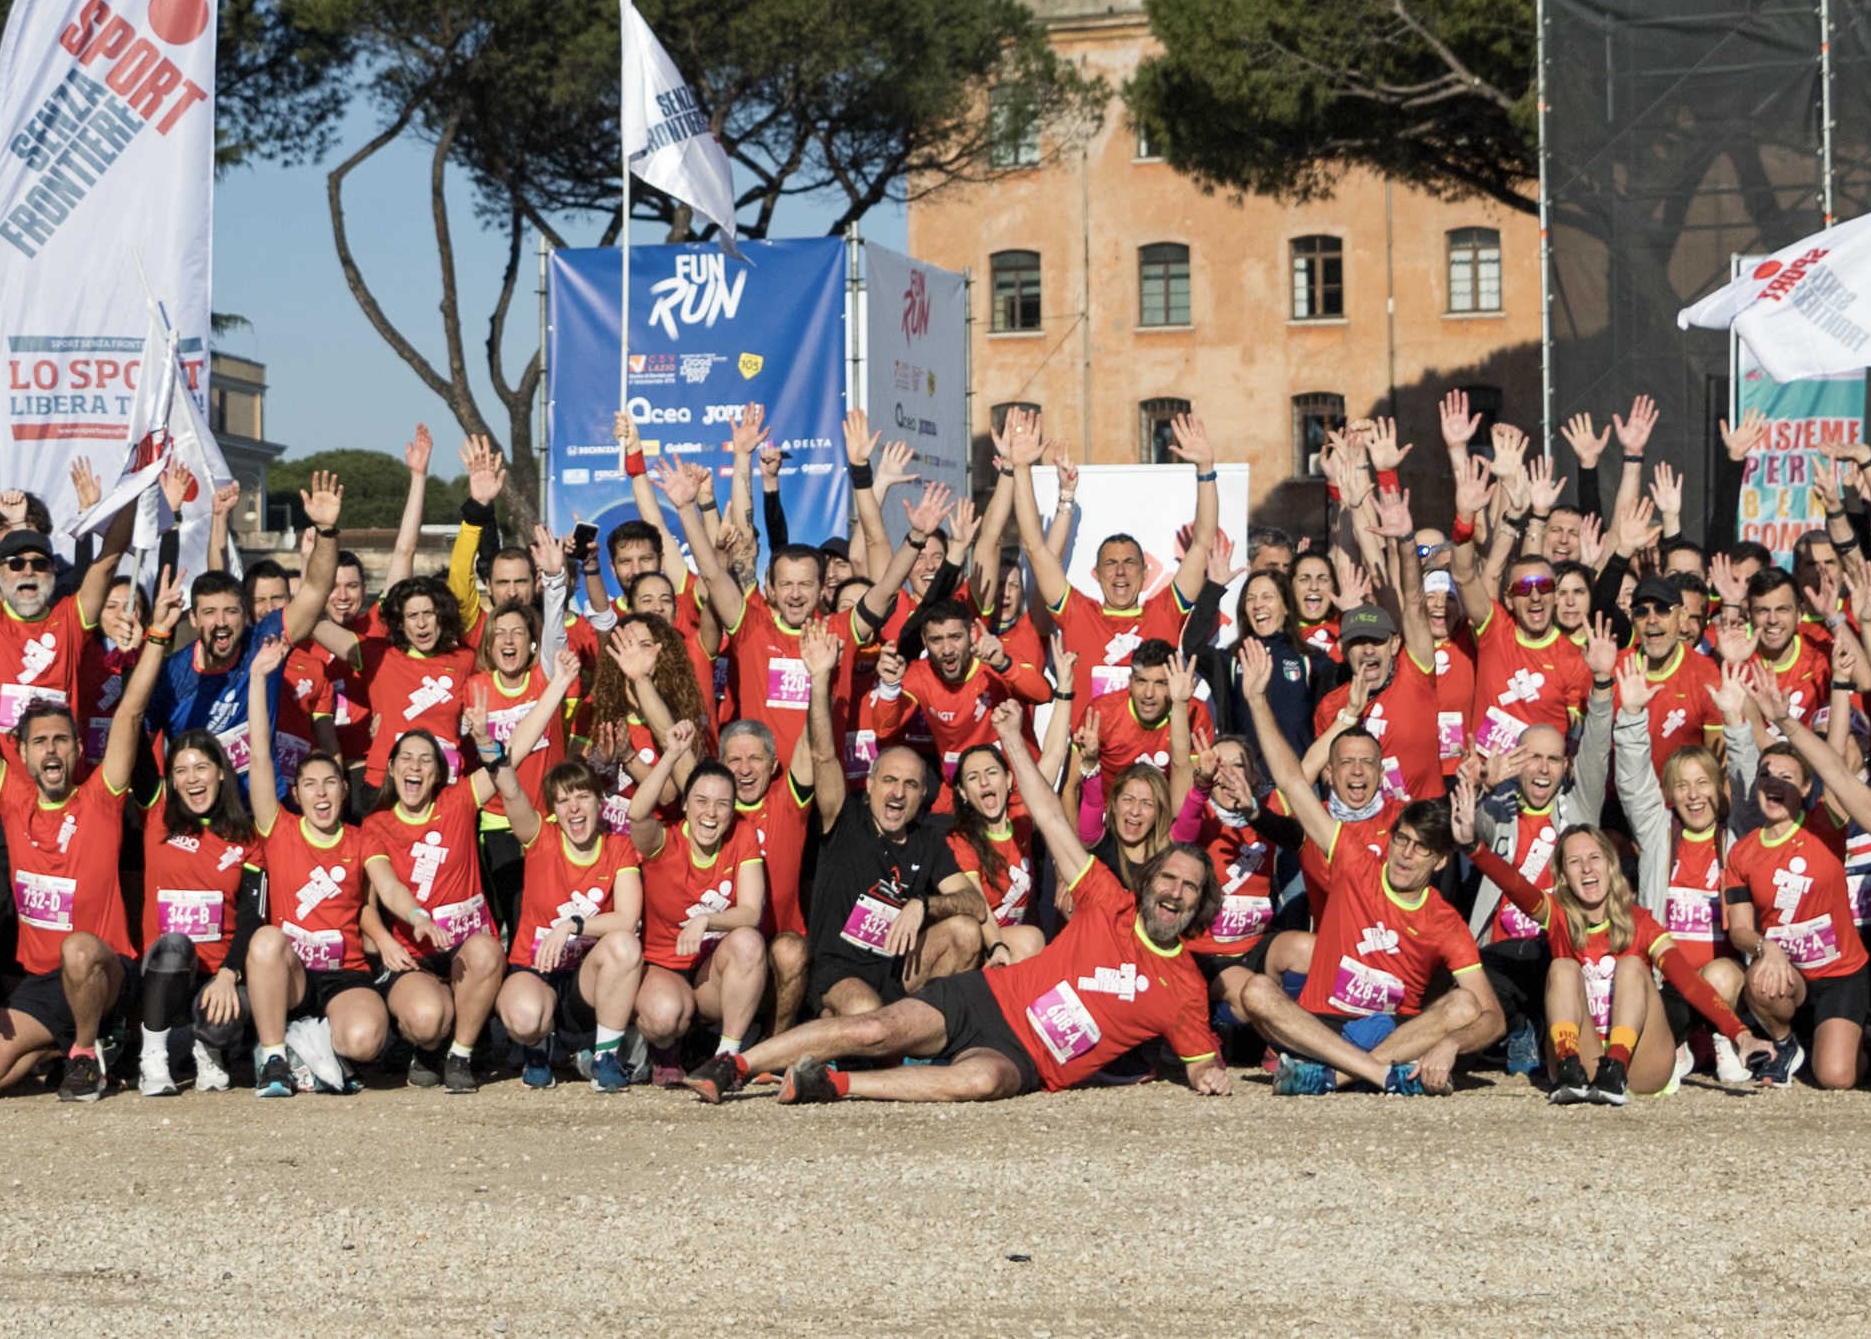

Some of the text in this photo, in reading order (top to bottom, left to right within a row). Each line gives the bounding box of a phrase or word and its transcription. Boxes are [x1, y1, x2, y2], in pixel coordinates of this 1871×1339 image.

[656, 86, 697, 118] SENZ
[10, 67, 109, 173] SENZA
[675, 254, 725, 284] FUN
[648, 269, 747, 341] RUN
[51, 340, 79, 349] SPORT
[112, 340, 145, 349] FRONTI
[9, 360, 204, 391] LO SPOT
[10, 395, 108, 416] LIBERA
[793, 438, 832, 449] DELTA
[1754, 419, 1860, 452] NSIEME
[1742, 454, 1805, 484] PER
[1743, 488, 1826, 518] BEN
[779, 673, 812, 693] 320-
[1487, 724, 1517, 749] 340-
[603, 808, 630, 826] 660-
[23, 892, 61, 912] 732-D
[1669, 905, 1711, 923] 331-C
[167, 906, 210, 924] 344-B
[447, 914, 481, 938] 343-B
[859, 912, 888, 934] 332-
[1221, 910, 1261, 928] 725-D
[1345, 976, 1389, 1003] 428-A
[1046, 1003, 1080, 1046] 608-A
